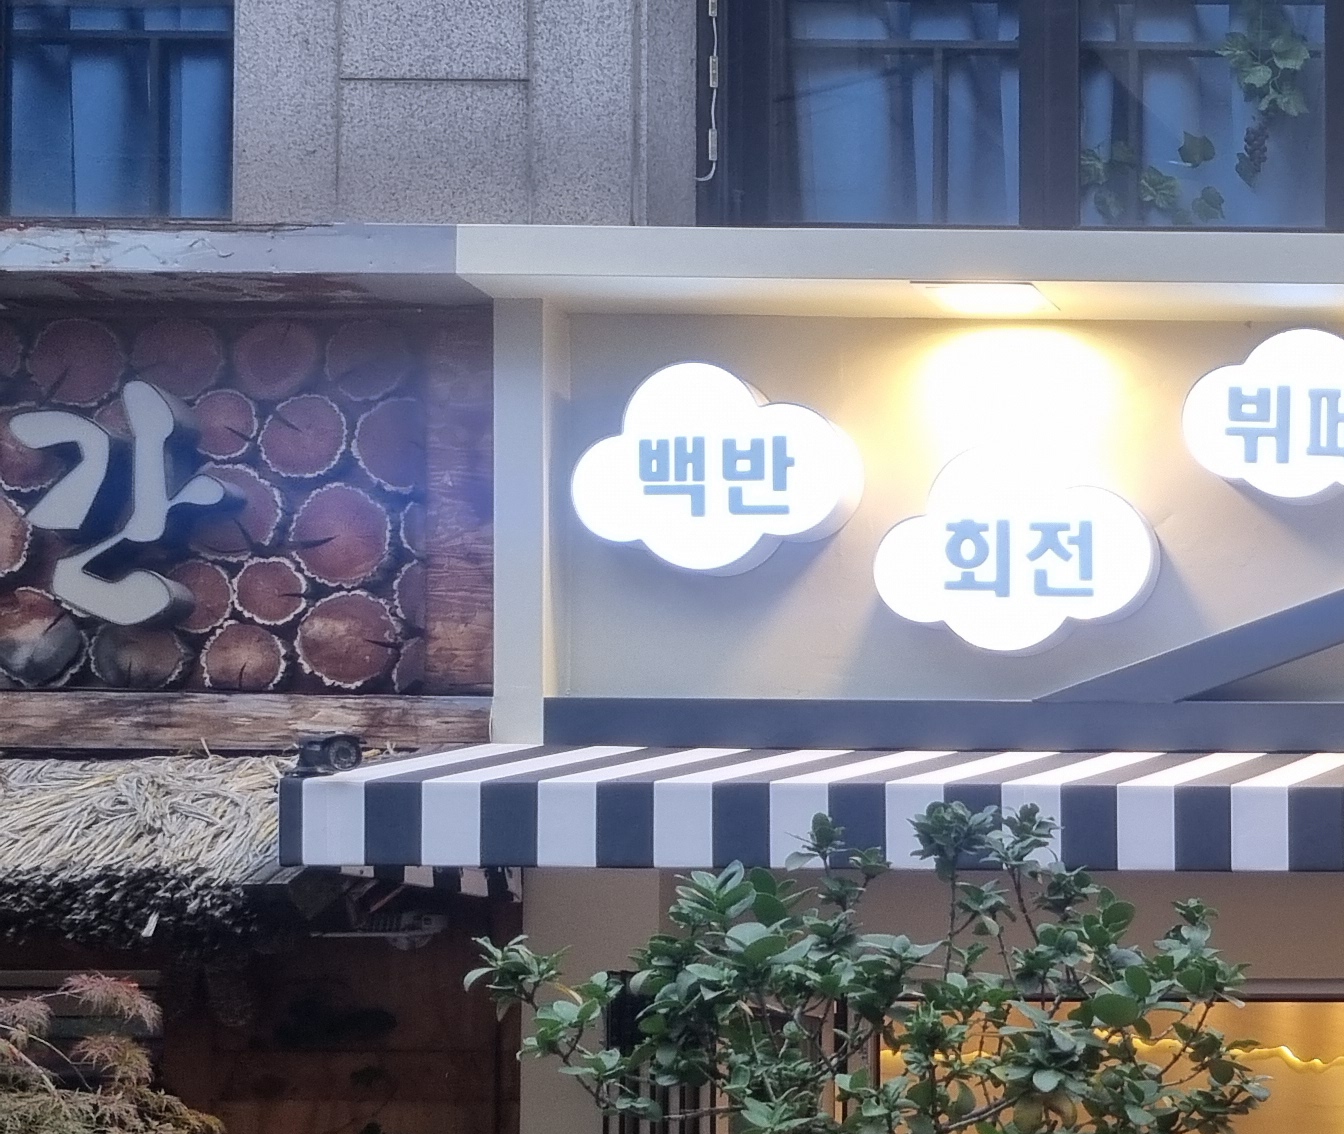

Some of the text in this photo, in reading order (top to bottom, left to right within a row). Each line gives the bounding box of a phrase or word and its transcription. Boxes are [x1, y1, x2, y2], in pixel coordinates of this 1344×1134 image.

[9, 381, 226, 626] 간
[638, 434, 795, 518] 백반
[943, 518, 1095, 598] 회전
